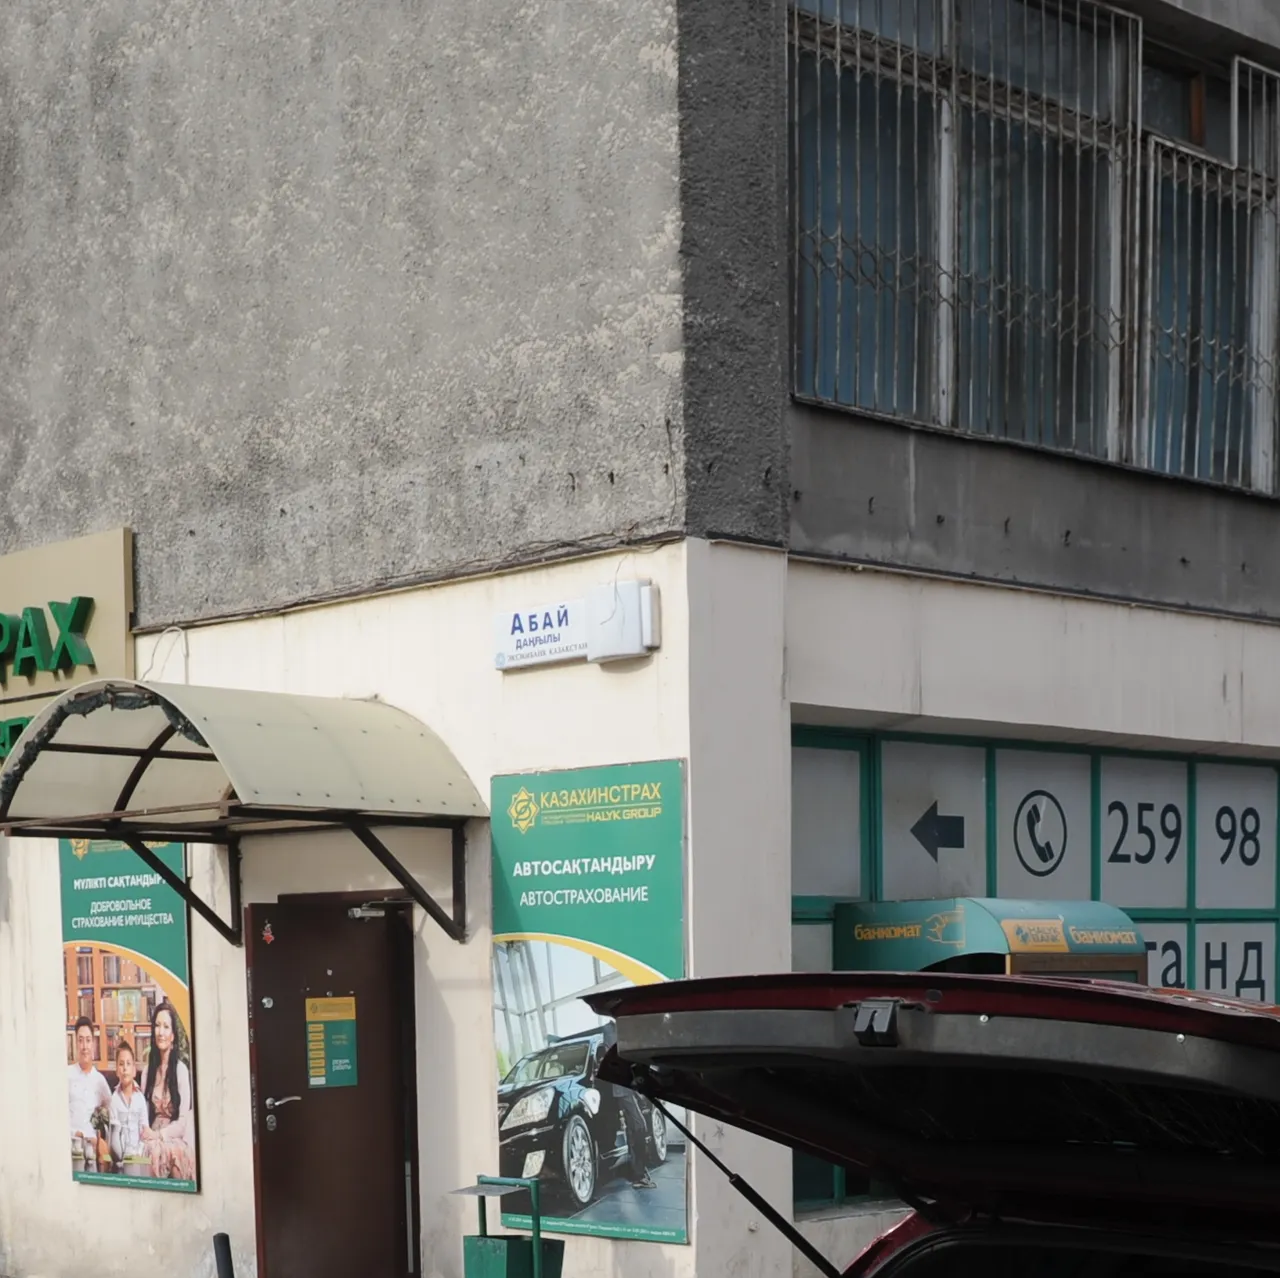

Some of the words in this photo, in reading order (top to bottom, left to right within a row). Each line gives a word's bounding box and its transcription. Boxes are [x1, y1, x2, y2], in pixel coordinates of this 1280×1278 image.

[511, 605, 569, 635] АБАЙ
[540, 783, 662, 808] КАЗАХИНСТРАХ
[586, 810, 620, 822] HALYK
[622, 807, 662, 819] GROUP
[1107, 801, 1182, 864] 259
[1215, 806, 1261, 866] 98
[513, 854, 656, 877] АВТОСАҚТАНДЫРУ
[107, 874, 166, 889] САҚТАНДЫР
[520, 886, 648, 907] АВТОСТРАХОВАНИЕ
[90, 898, 152, 915] ДОБРОВОЛЬНОЕ
[71, 915, 124, 928] СТРАХОВАНИЕ
[124, 913, 174, 927] ИМУЩЕСТВА
[854, 924, 922, 941] банкомат
[1069, 925, 1138, 944] банкомат
